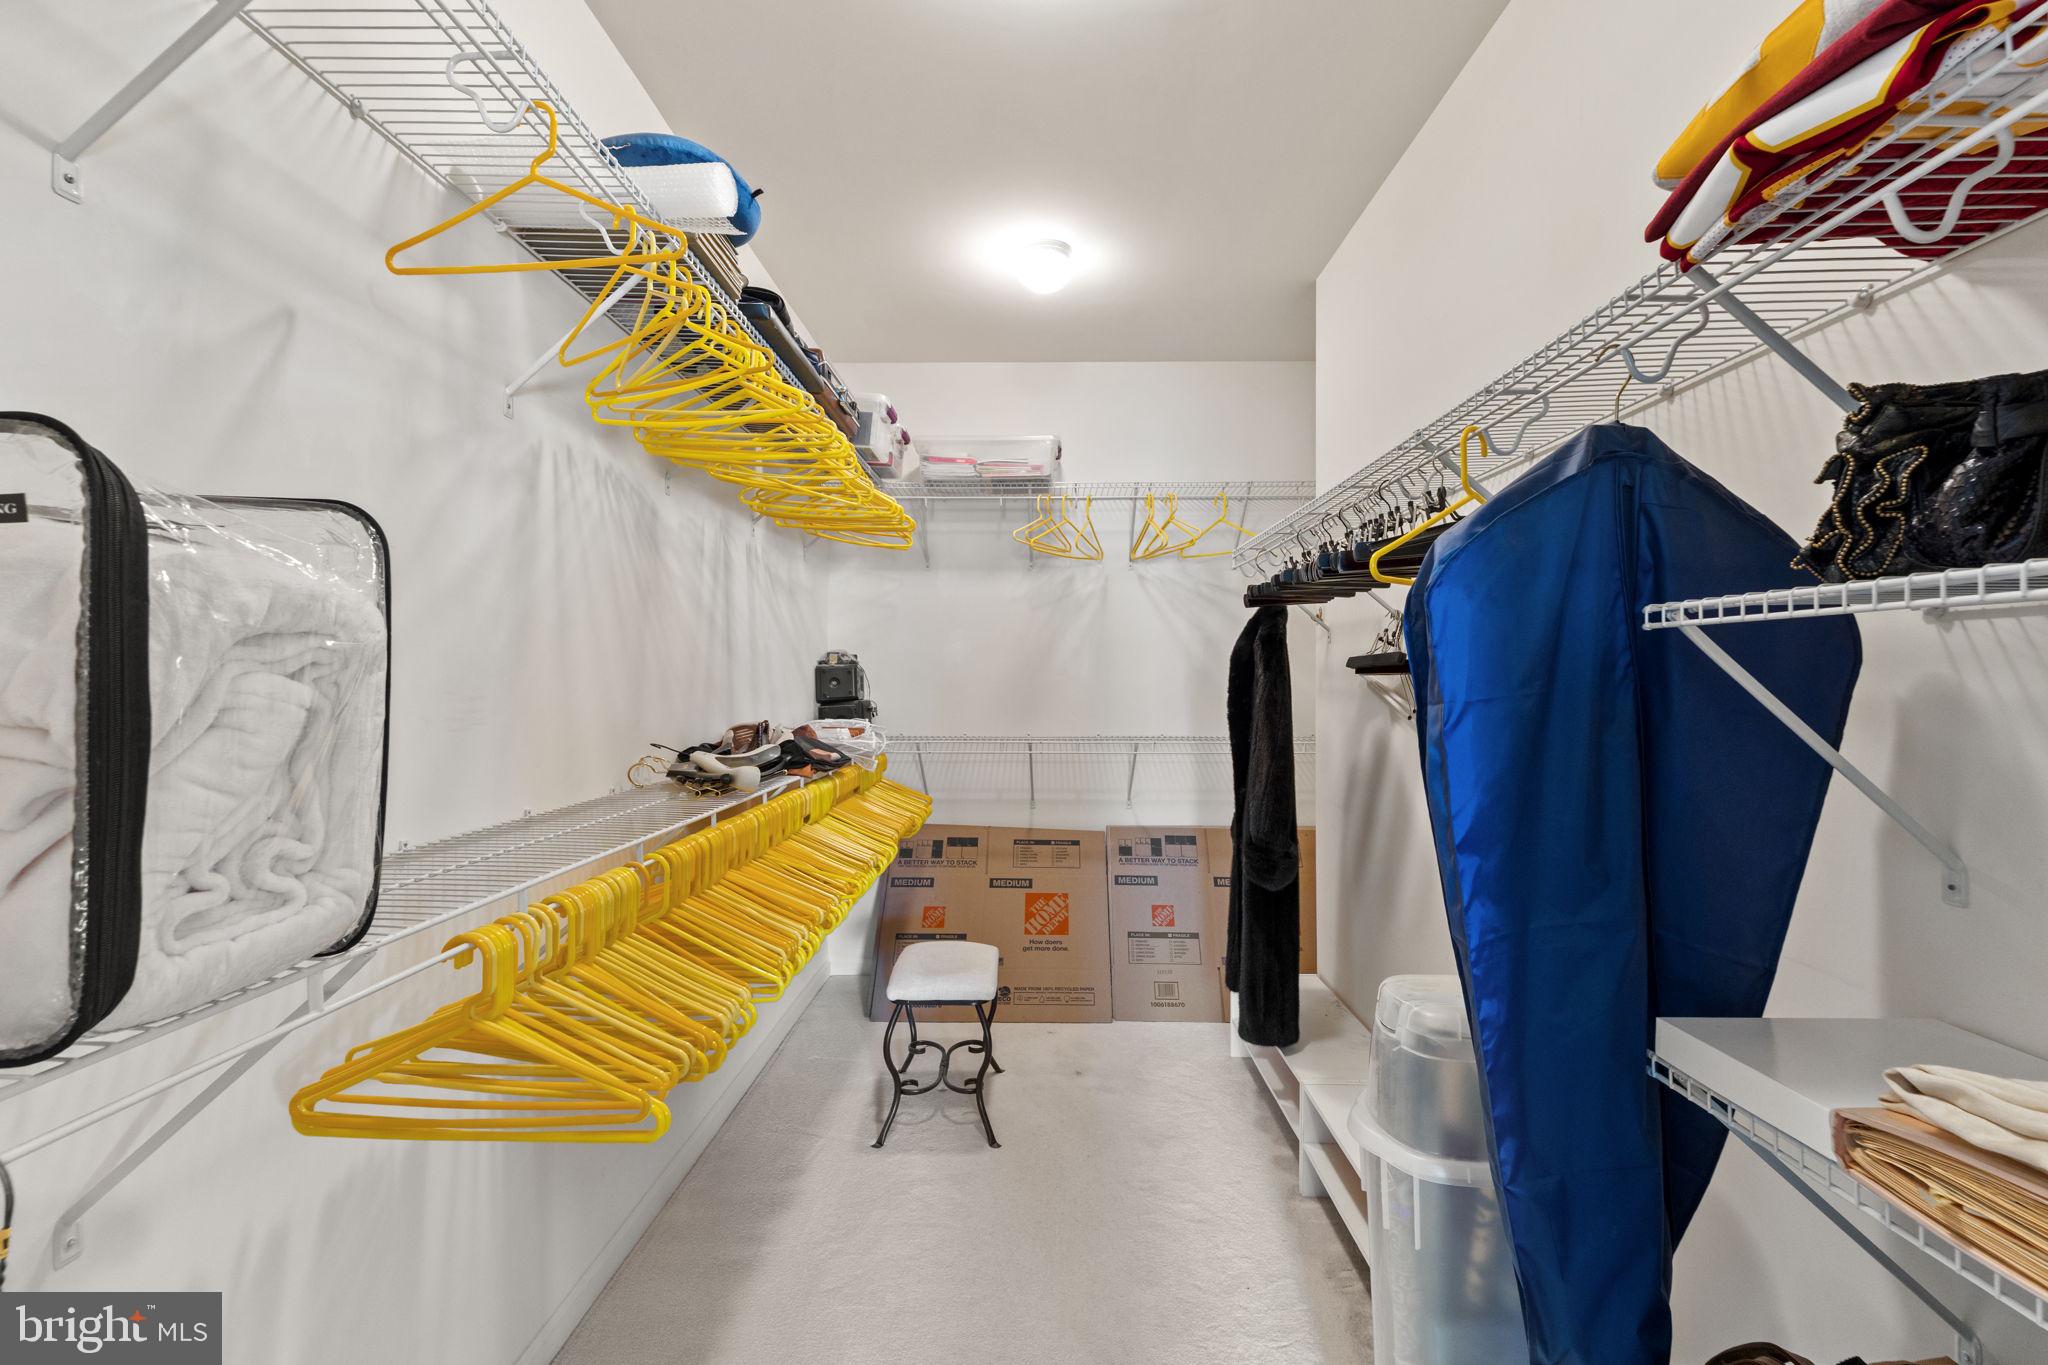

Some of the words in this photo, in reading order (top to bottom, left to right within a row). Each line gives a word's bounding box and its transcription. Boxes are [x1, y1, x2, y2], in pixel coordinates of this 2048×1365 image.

[992, 879, 1030, 887] MEDIUM
[1118, 876, 1155, 884] MEDIUM
[1025, 893, 1069, 934] HOME
[1029, 896, 1047, 914] THE
[1041, 908, 1068, 935] DEPOT
